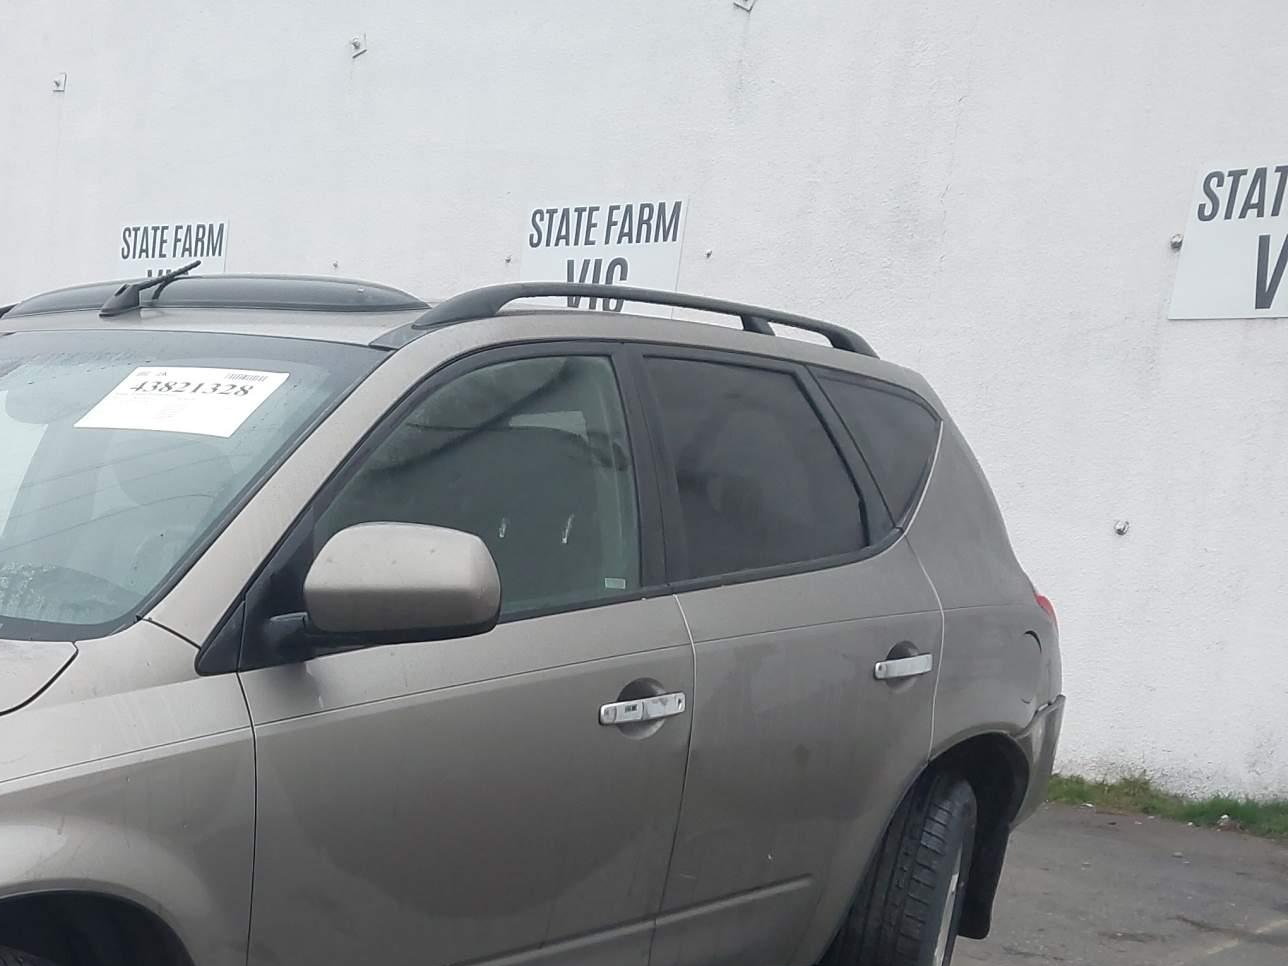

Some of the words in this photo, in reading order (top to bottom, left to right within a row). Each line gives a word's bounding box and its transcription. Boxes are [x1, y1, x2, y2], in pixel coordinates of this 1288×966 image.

[121, 225, 169, 259] STATE
[172, 223, 224, 258] FARM
[529, 206, 601, 248] STATE
[605, 201, 682, 245] FARM
[566, 257, 629, 313] VIC
[130, 380, 254, 397] 43821328
